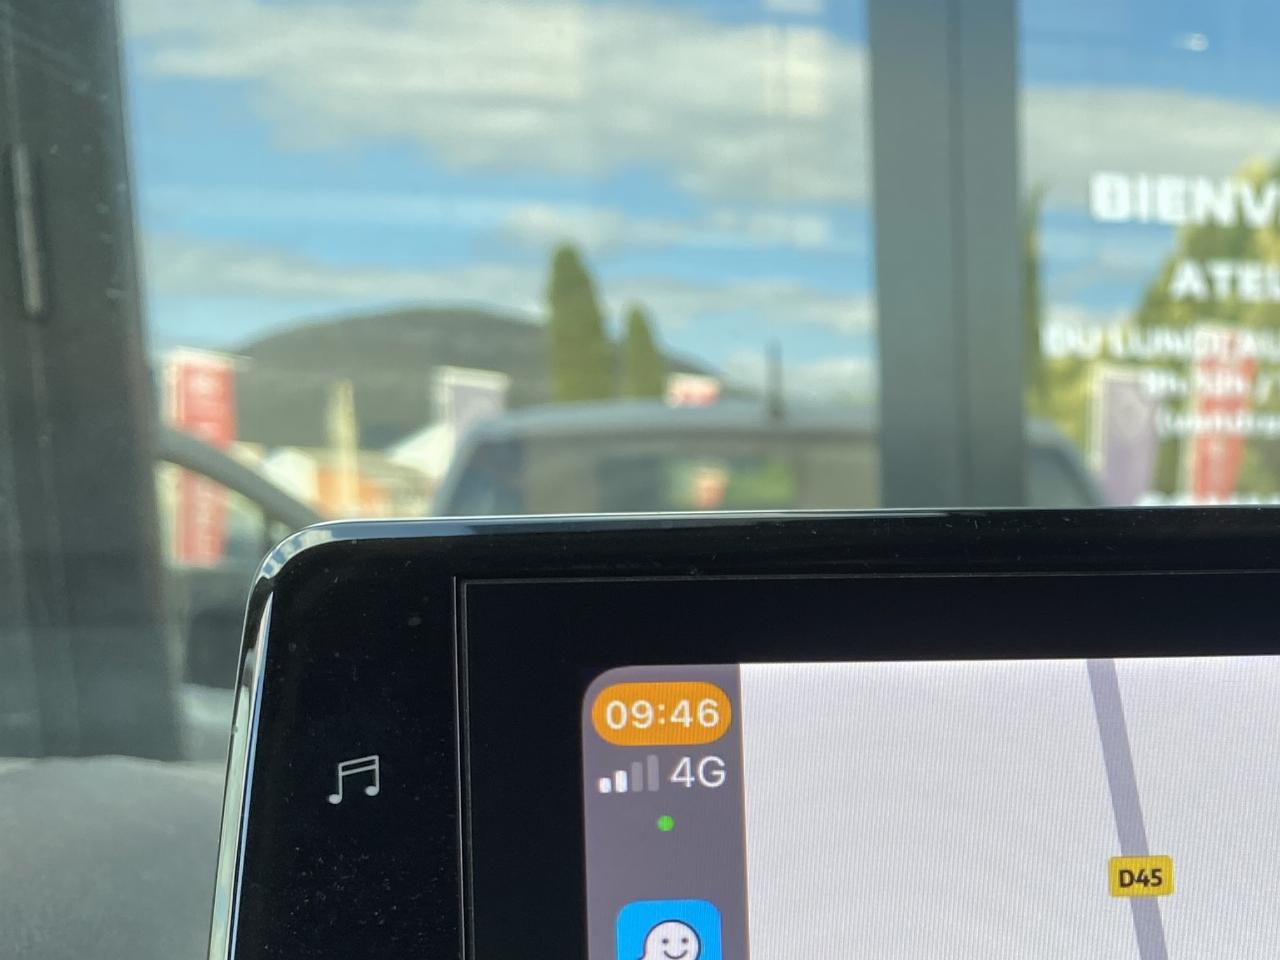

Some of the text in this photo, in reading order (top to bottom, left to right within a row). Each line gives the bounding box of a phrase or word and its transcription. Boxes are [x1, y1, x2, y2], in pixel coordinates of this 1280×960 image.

[605, 698, 721, 731] 09:46
[670, 755, 728, 788] 4G
[1118, 867, 1164, 889] D45
